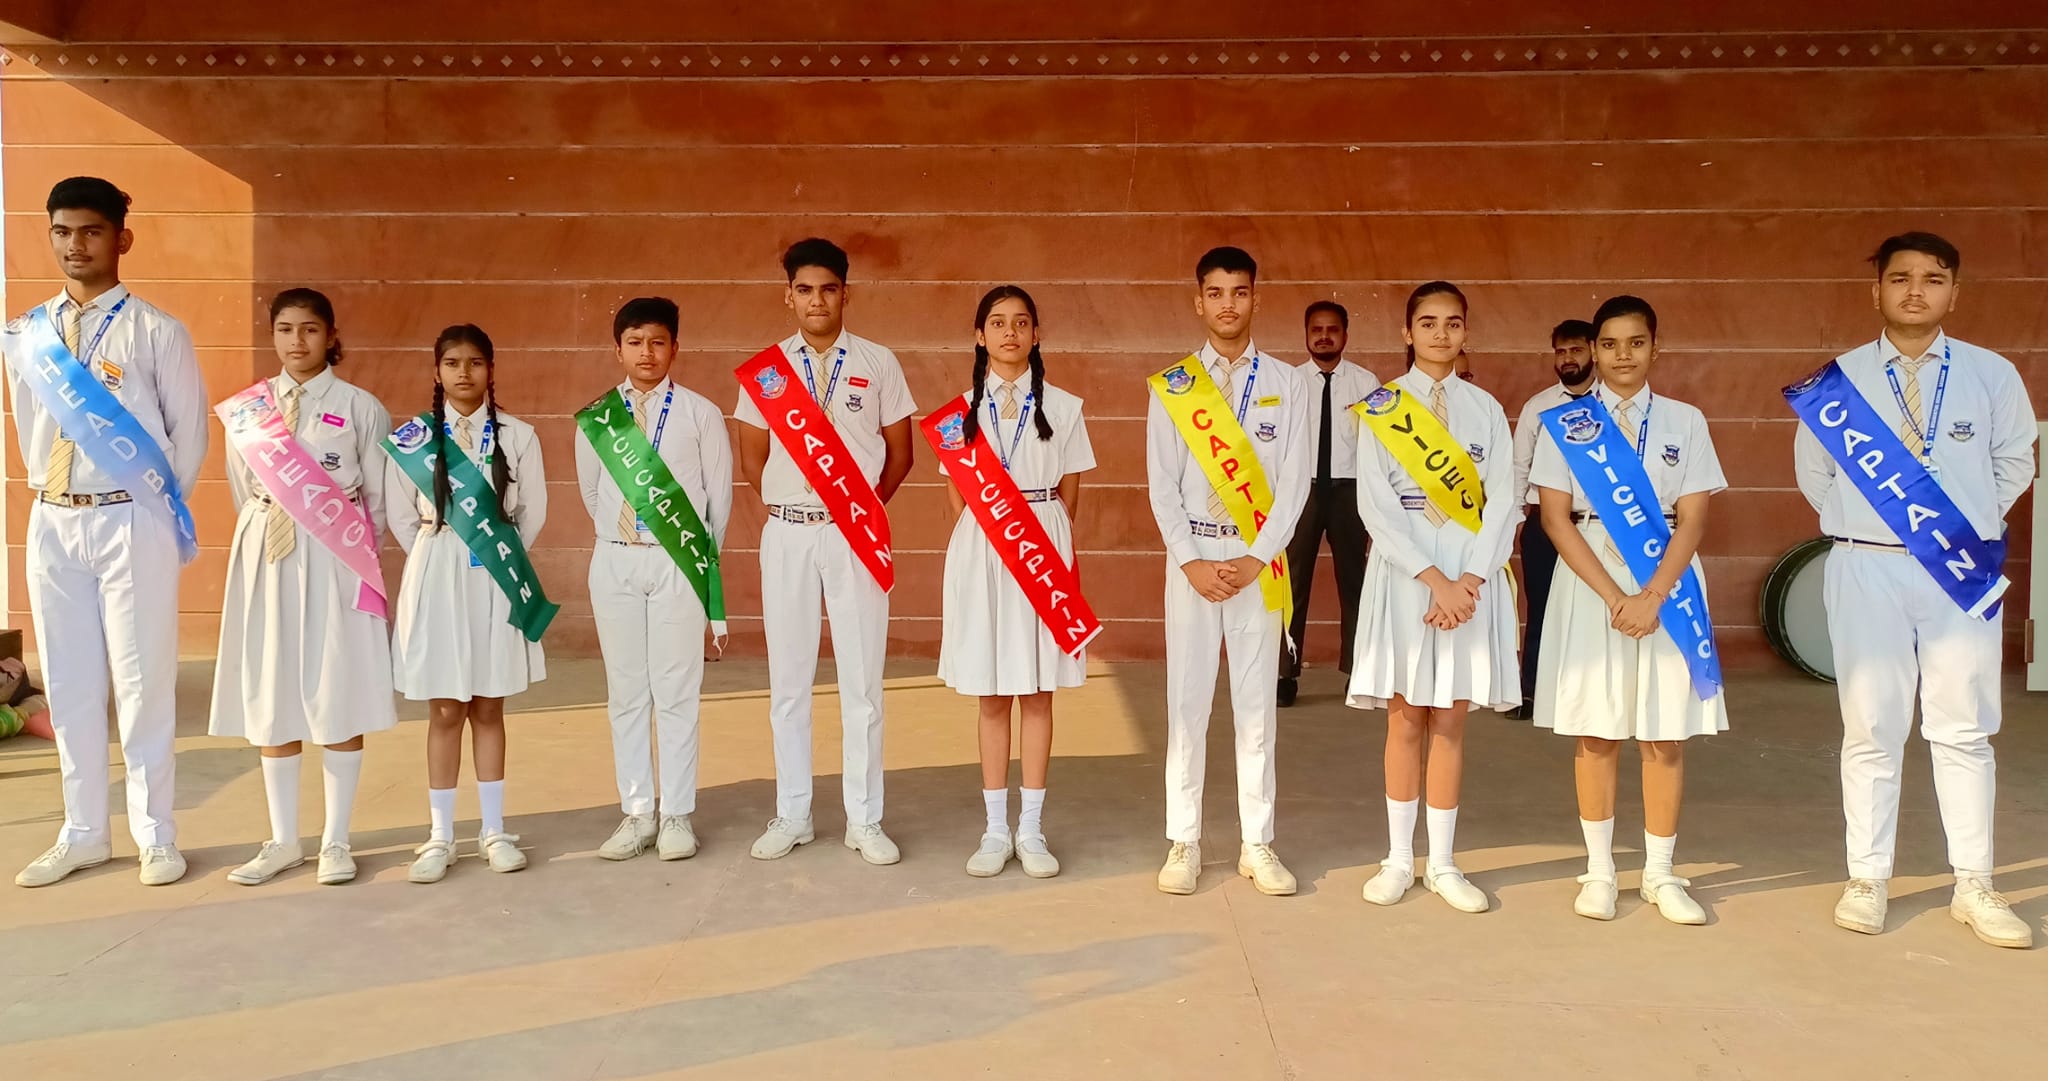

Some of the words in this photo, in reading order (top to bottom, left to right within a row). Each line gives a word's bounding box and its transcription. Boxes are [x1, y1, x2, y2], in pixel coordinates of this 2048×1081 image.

[35, 355, 138, 462] HEAD
[258, 435, 344, 526] HEAD
[1390, 413, 1465, 491] VICE
[1585, 444, 1646, 528] VICE
[595, 408, 640, 470] VICE
[635, 468, 709, 576] CAPTAIN
[786, 409, 892, 568] CAPTAIN
[959, 448, 1012, 521] VICE
[1003, 521, 1088, 642] CAPTAIN
[1192, 408, 1284, 580] CAPTAN
[1819, 400, 1976, 582] CAPTAIN
